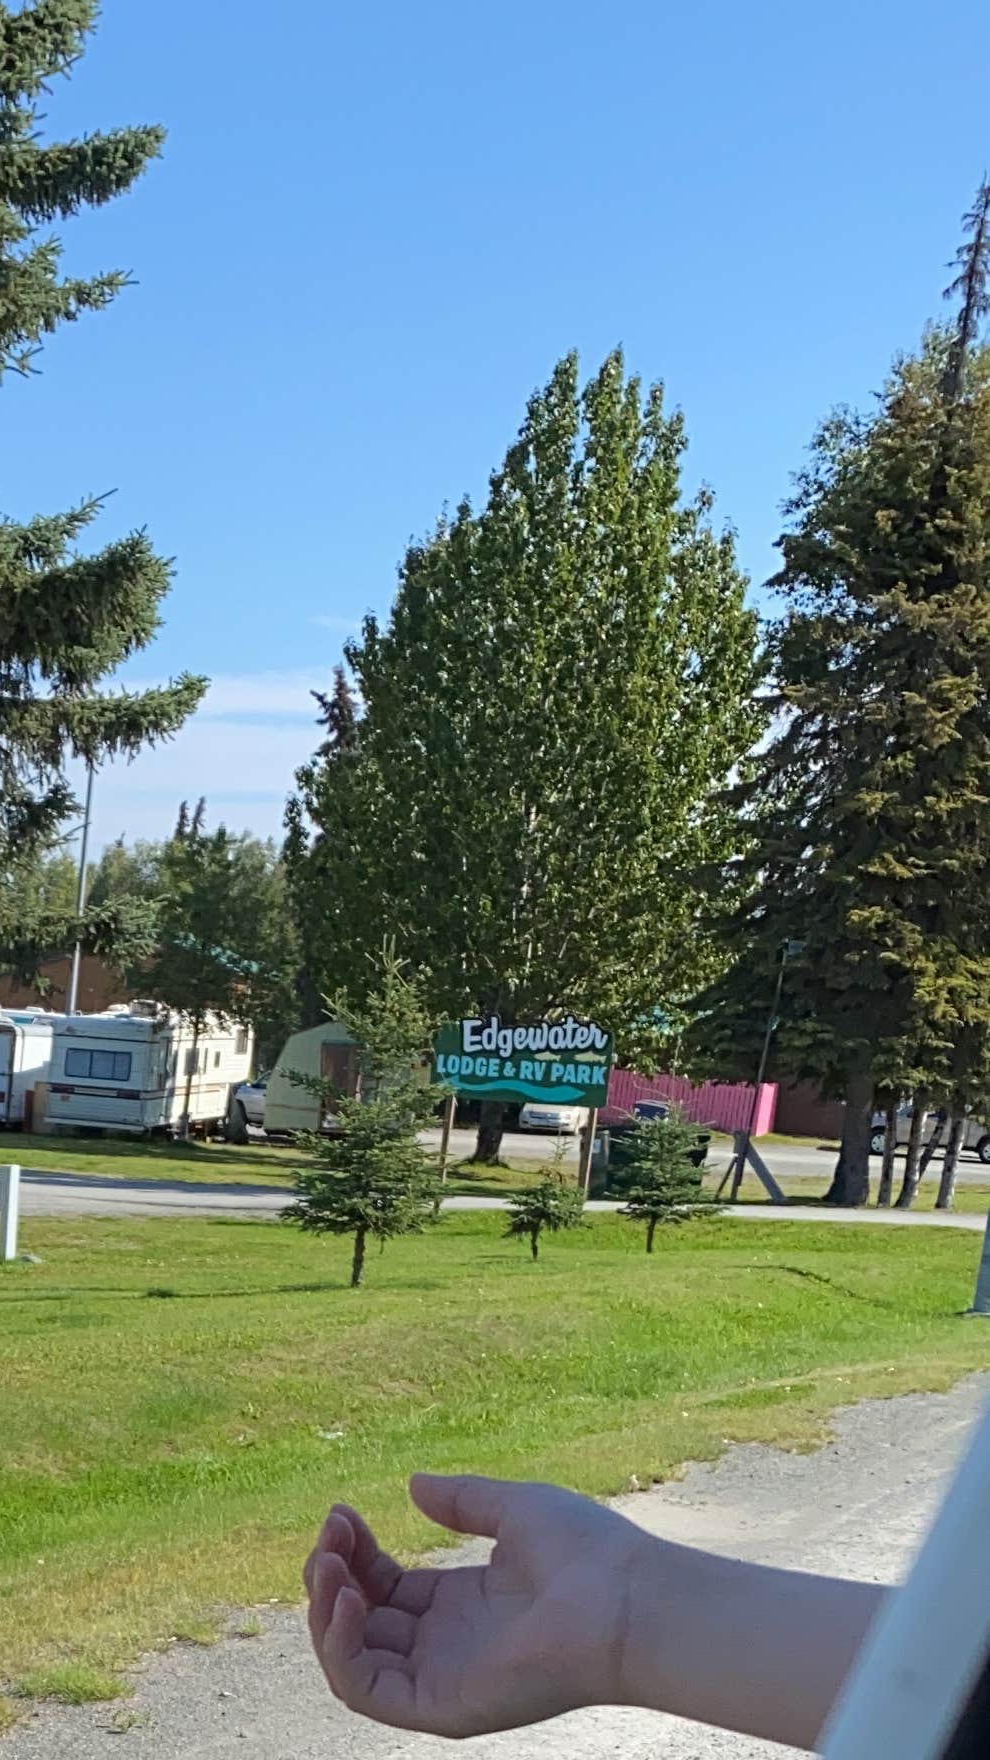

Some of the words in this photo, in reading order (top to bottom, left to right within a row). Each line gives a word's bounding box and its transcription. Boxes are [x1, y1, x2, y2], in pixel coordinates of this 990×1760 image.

[462, 1016, 608, 1057] Edgewater
[437, 1054, 500, 1077] LODGE
[503, 1061, 516, 1077] &
[519, 1061, 546, 1080] RV
[551, 1063, 607, 1085] PARK
